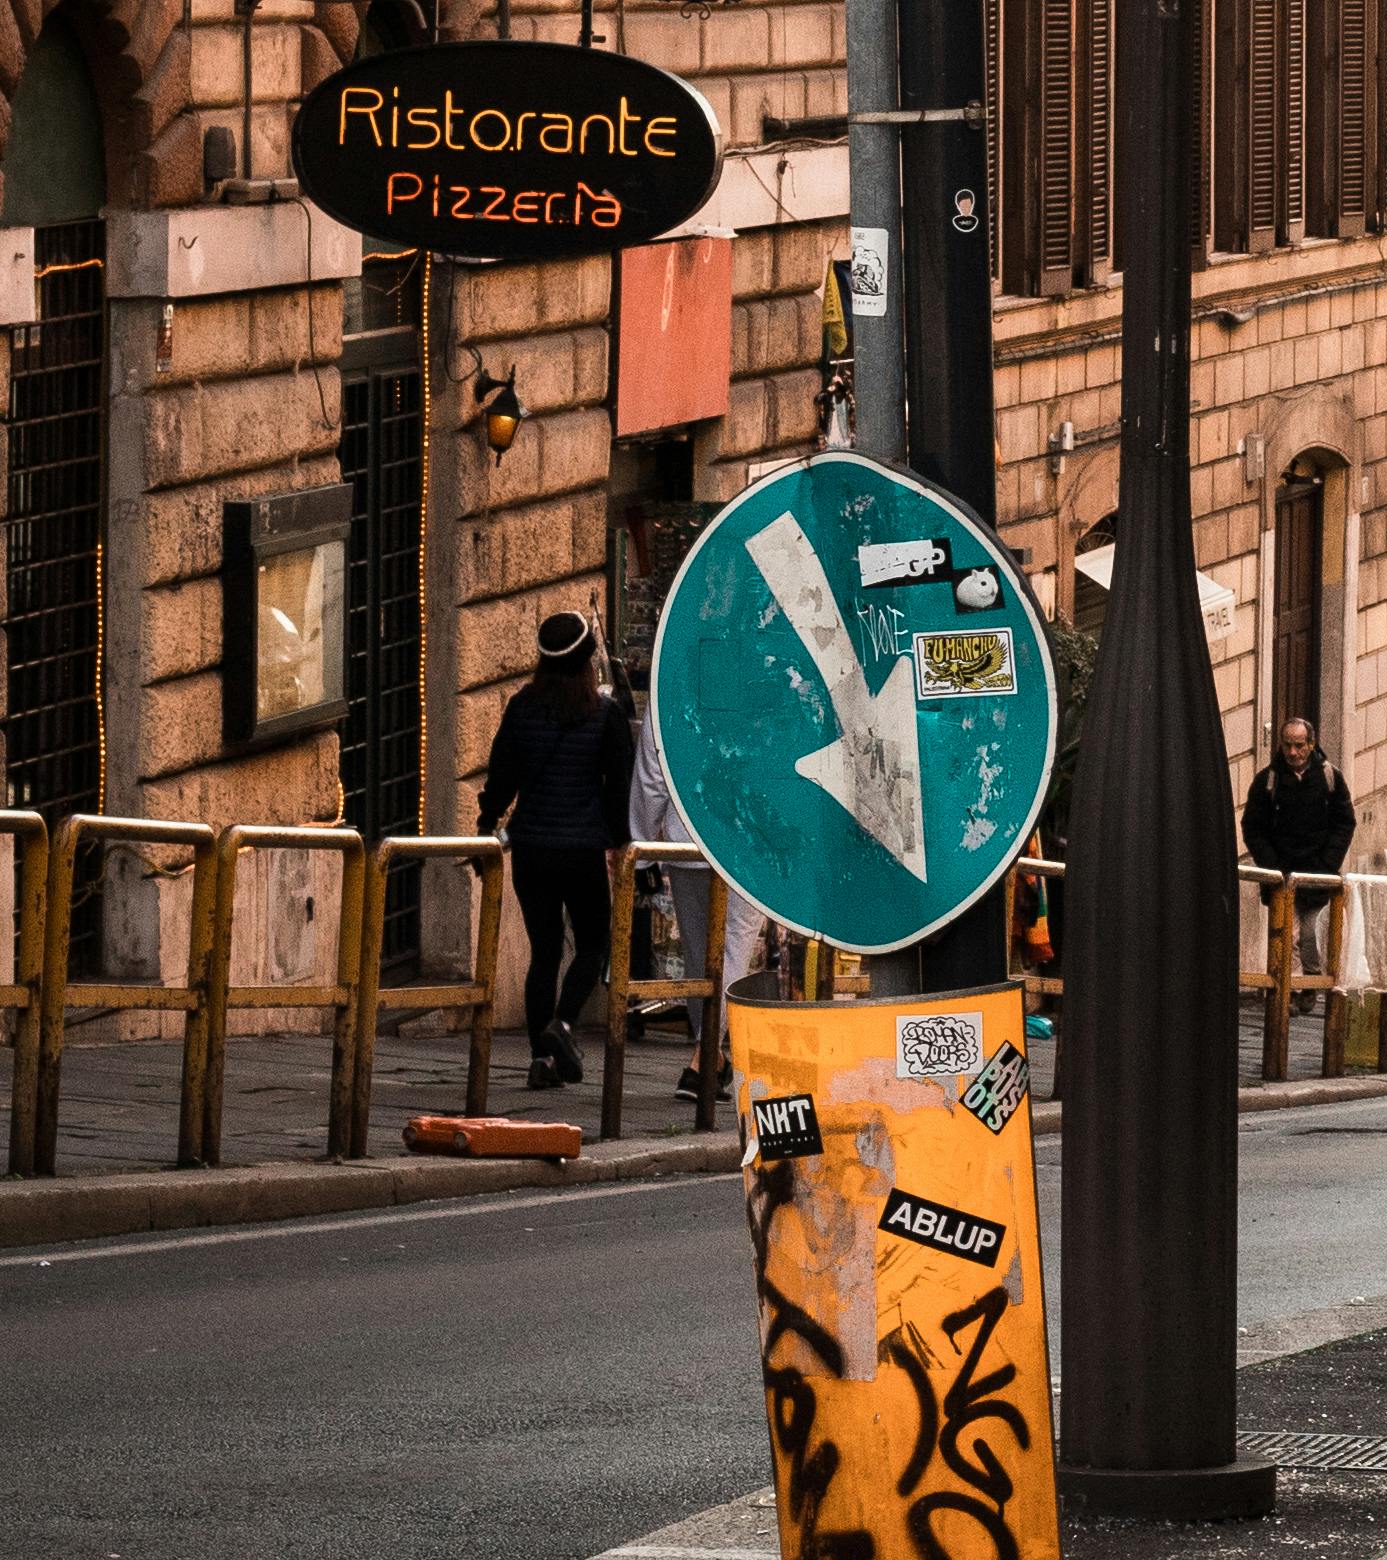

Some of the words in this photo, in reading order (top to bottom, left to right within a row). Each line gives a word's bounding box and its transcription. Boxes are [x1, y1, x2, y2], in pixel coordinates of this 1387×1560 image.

[339, 86, 677, 157] Ristorante
[756, 1099, 811, 1136] NKT
[888, 1200, 998, 1255] ABLUP
